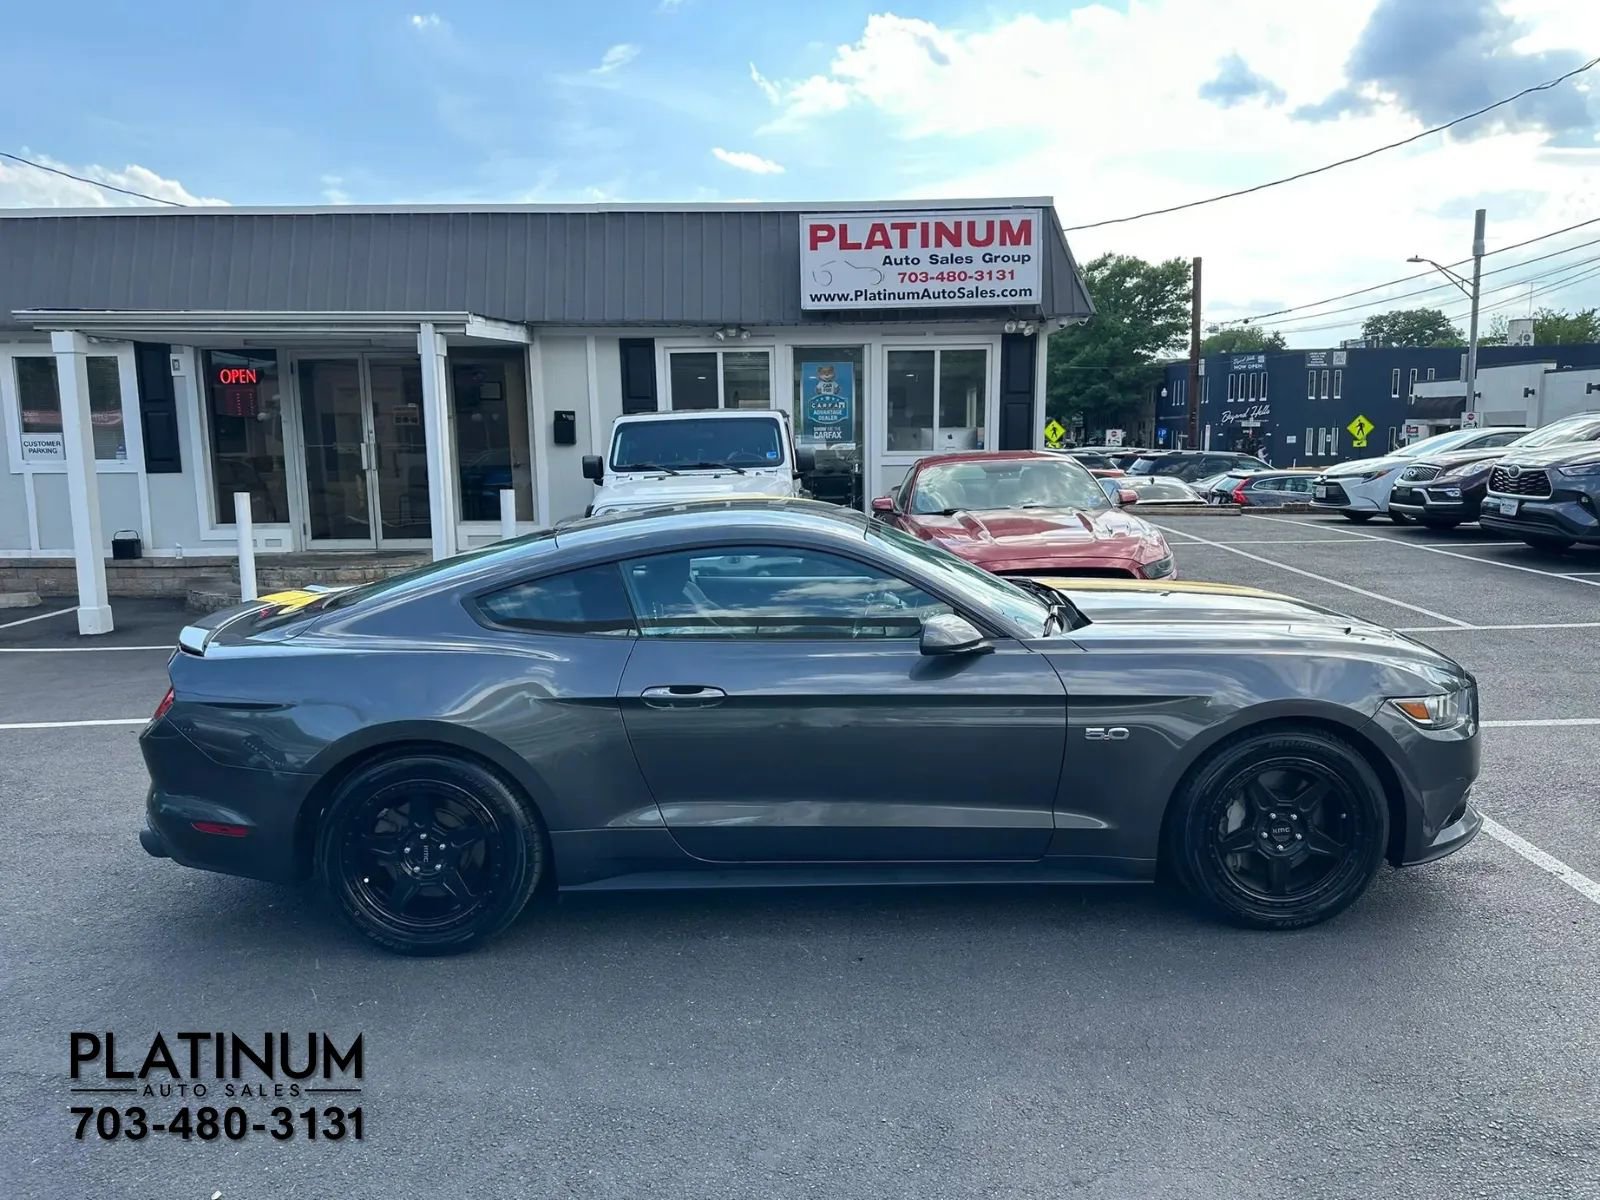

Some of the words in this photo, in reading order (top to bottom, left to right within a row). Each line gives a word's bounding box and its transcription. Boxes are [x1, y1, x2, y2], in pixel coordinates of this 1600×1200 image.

[809, 219, 1032, 251] PLATINUM
[882, 255, 921, 266] Auto
[929, 253, 974, 265] Sales
[982, 252, 1032, 266] Group
[898, 269, 1015, 284] 703-480-3131
[809, 286, 1033, 303] www.PlatinumAutoSales.com
[219, 368, 257, 384] OPEN
[813, 431, 842, 439] CARFAX
[1084, 727, 1130, 741] 5.0
